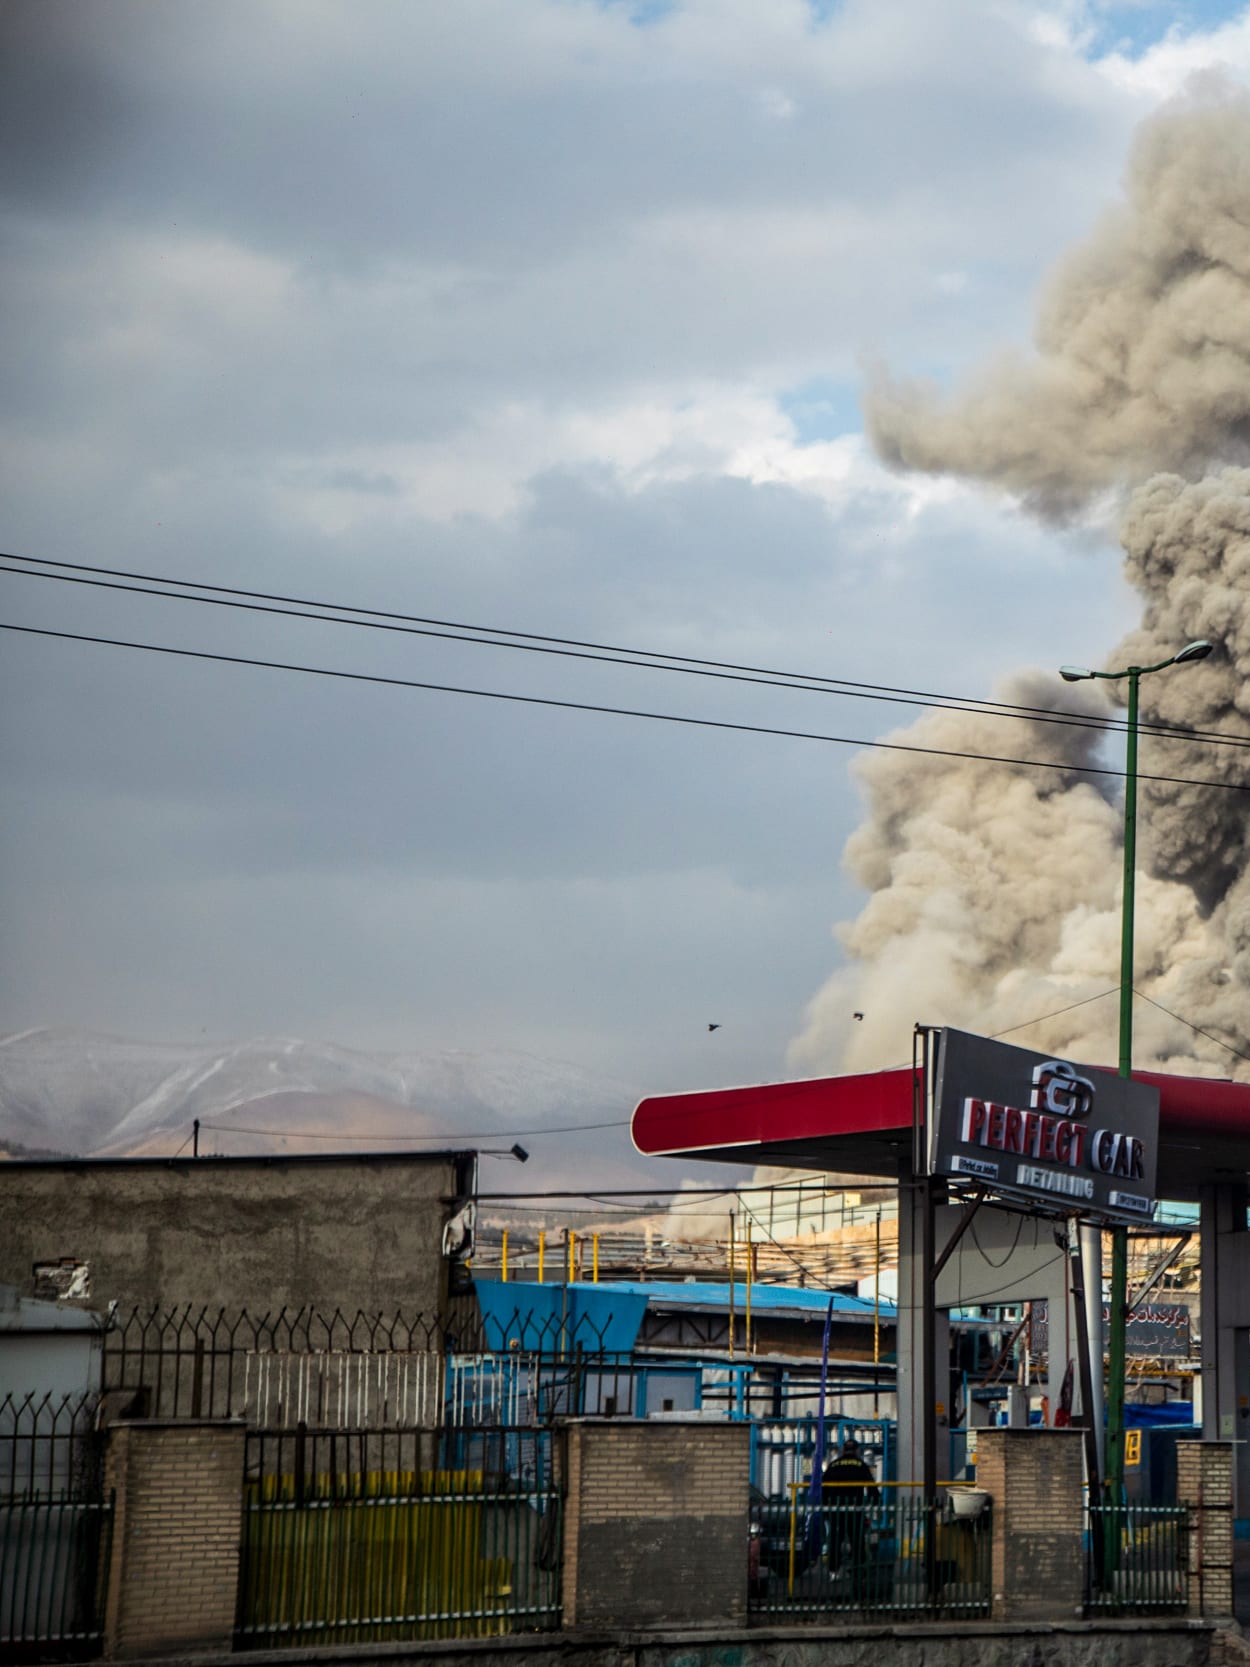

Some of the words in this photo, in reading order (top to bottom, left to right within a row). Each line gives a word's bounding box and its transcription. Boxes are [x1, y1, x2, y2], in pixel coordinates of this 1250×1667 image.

[961, 1097, 1089, 1167] PERFECT
[1091, 1129, 1145, 1179] CAR
[1016, 1164, 1095, 1199] DETAILING
